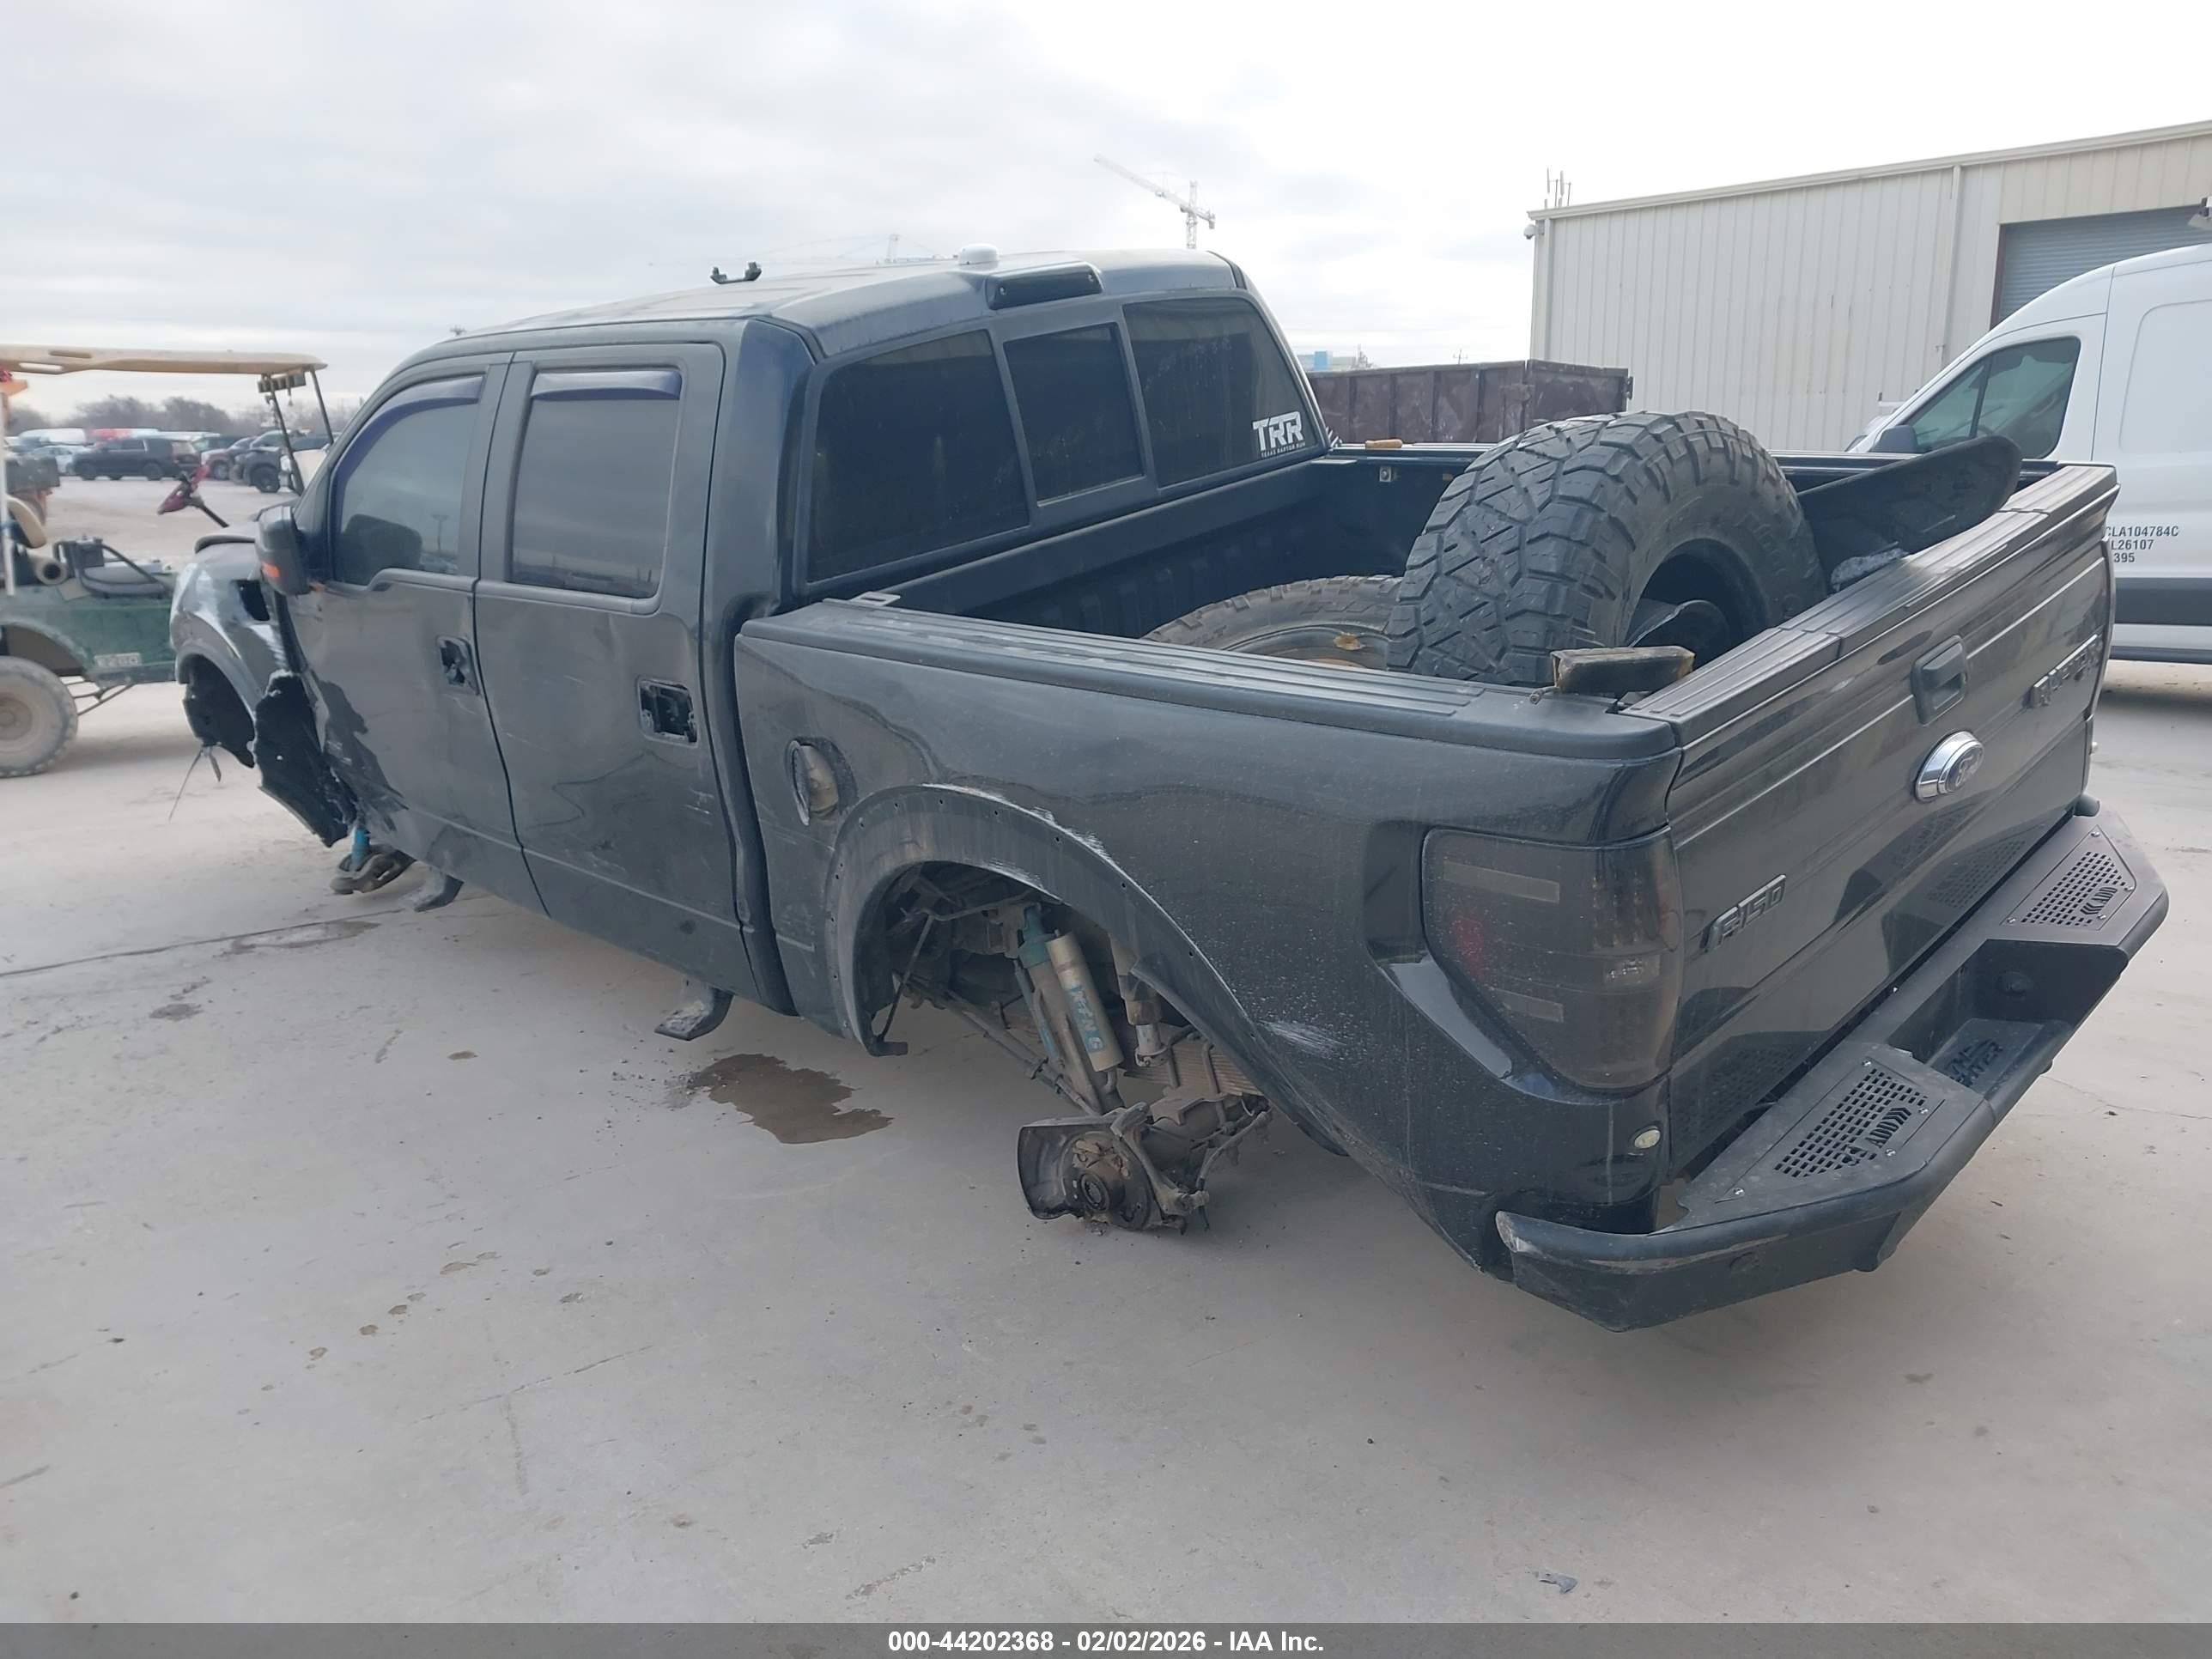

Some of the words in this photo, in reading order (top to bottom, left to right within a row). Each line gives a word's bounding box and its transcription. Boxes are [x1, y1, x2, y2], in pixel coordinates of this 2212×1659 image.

[1253, 411, 1304, 451] TRR
[2111, 539, 2154, 550] L26107
[2113, 553, 2136, 563] 395
[2091, 887, 2118, 904] ADD
[1865, 1121, 1900, 1148] ADD
